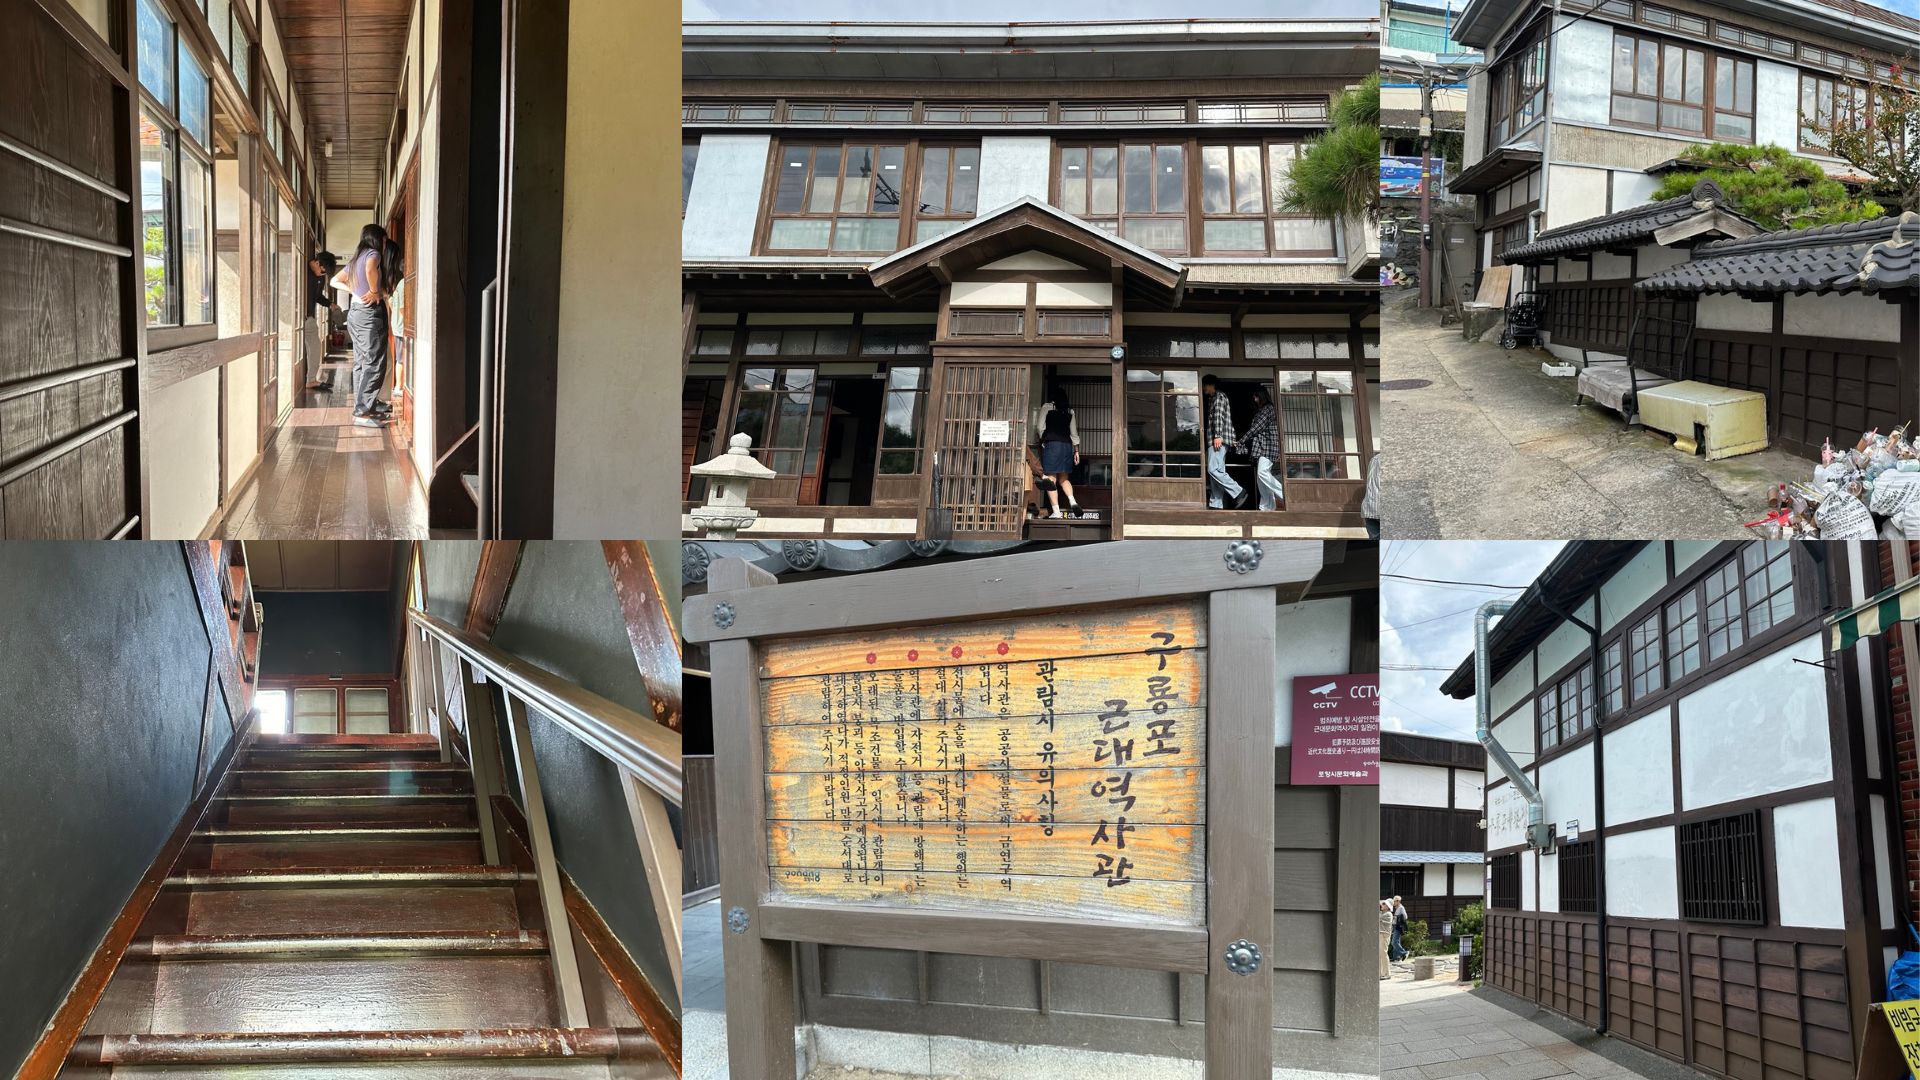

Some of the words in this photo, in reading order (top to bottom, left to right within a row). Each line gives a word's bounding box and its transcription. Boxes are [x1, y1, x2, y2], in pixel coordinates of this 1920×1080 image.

[821, 673, 832, 724] 관람하여
[867, 672, 881, 710] 오래된
[892, 669, 904, 709] 물품을
[909, 668, 921, 721] 역사관에
[935, 665, 947, 693] 절대
[952, 665, 965, 718] 전시물에
[979, 662, 992, 706] 입니다
[997, 662, 1011, 721] 역사관은
[1036, 659, 1058, 733] 관람시
[1143, 631, 1182, 756] 구룡포
[1349, 685, 1380, 699] CCTV
[835, 672, 849, 749] 대기하였다가
[853, 713, 864, 738] 붕괴
[893, 713, 906, 753] 반입할
[822, 730, 833, 767] 주시기
[854, 743, 866, 755] 등
[910, 728, 922, 768] 자전거
[936, 731, 948, 770] 주시기
[953, 722, 966, 748] 손을
[838, 753, 850, 803] 적정인원
[895, 757, 907, 771] 수
[912, 773, 924, 786] 등
[997, 728, 1012, 828] 공공시설물로써
[824, 773, 836, 821] 바랍니다
[896, 772, 908, 828] 없습니다
[938, 775, 951, 828] 바랍니다
[1036, 741, 1058, 837] 유의사항
[1091, 699, 1136, 888] 근대역사관
[840, 807, 852, 832] 만큼
[841, 835, 854, 884] 순서대로
[872, 834, 885, 886] 관람객이
[913, 835, 927, 887] 방해되는
